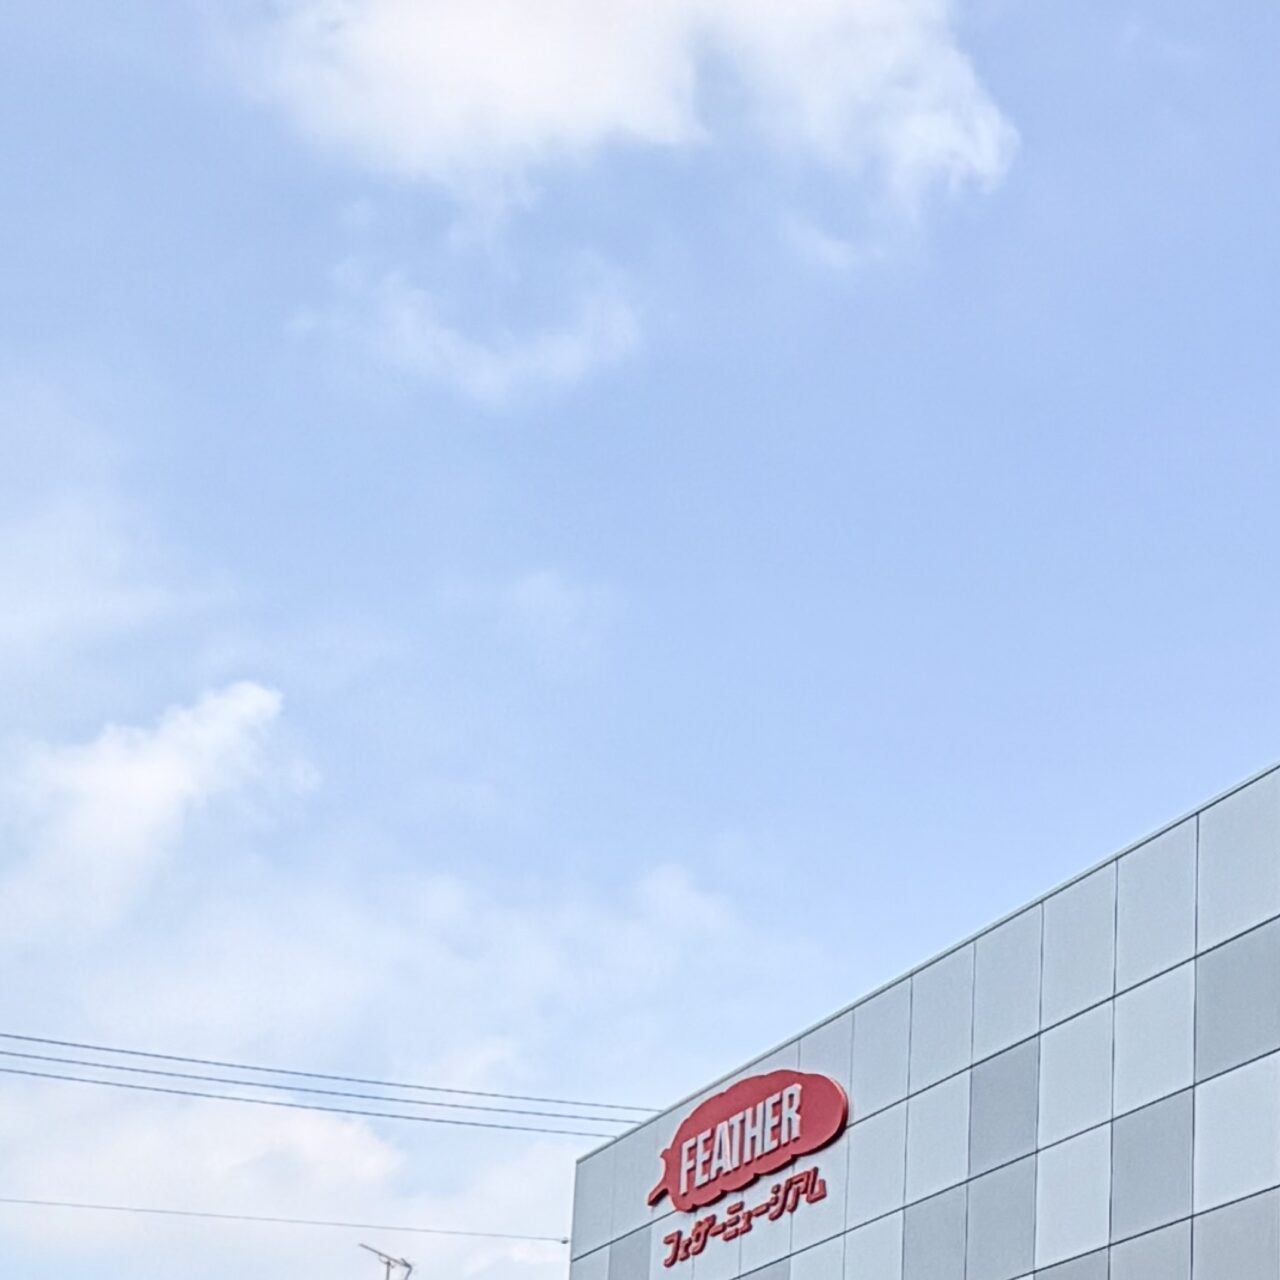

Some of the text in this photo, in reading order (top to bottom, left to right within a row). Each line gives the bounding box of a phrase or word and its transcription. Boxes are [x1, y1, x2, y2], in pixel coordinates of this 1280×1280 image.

[679, 1083, 802, 1196] FEATHER
[663, 1166, 827, 1268] フェザーミュージアム
